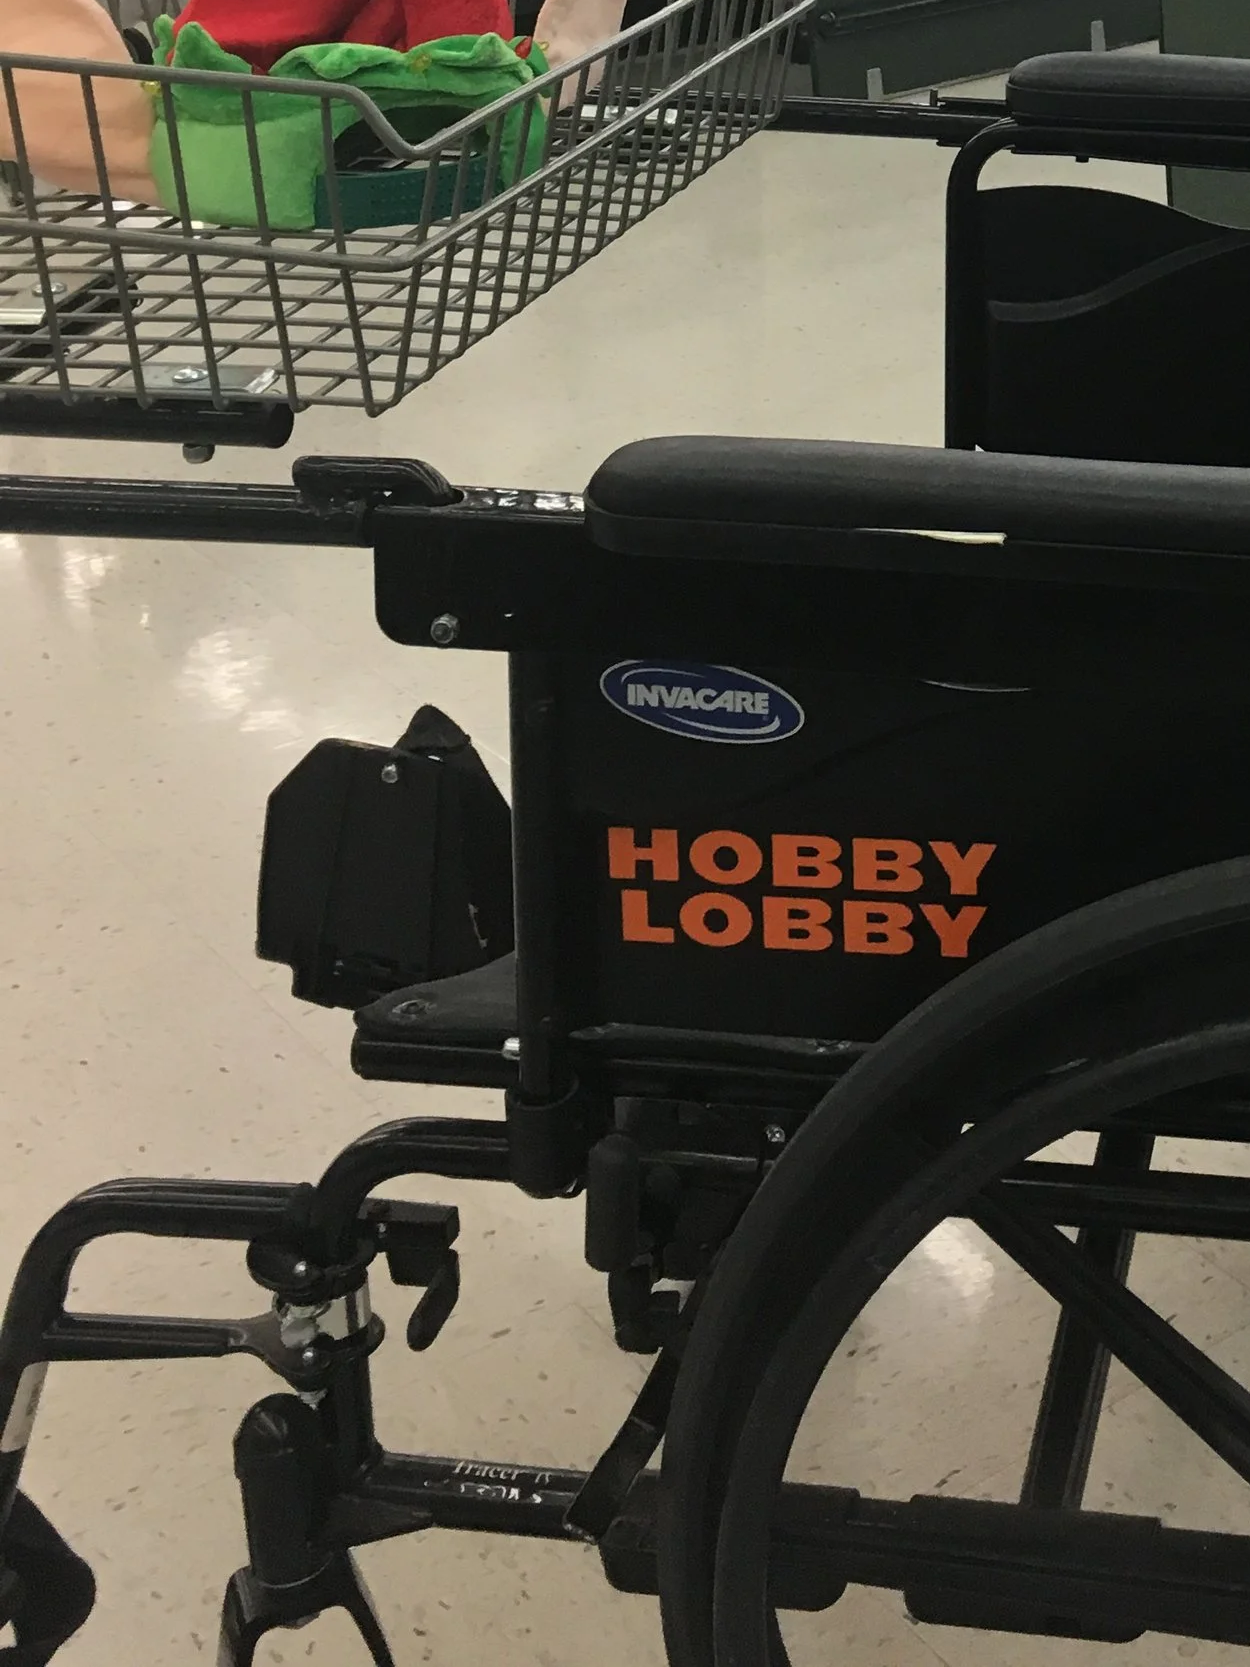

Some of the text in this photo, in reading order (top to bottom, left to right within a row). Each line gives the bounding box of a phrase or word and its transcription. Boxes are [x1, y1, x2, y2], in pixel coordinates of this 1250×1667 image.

[626, 683, 770, 716] INVACARE
[607, 827, 997, 896] HOBBY
[620, 889, 989, 959] LOBBY
